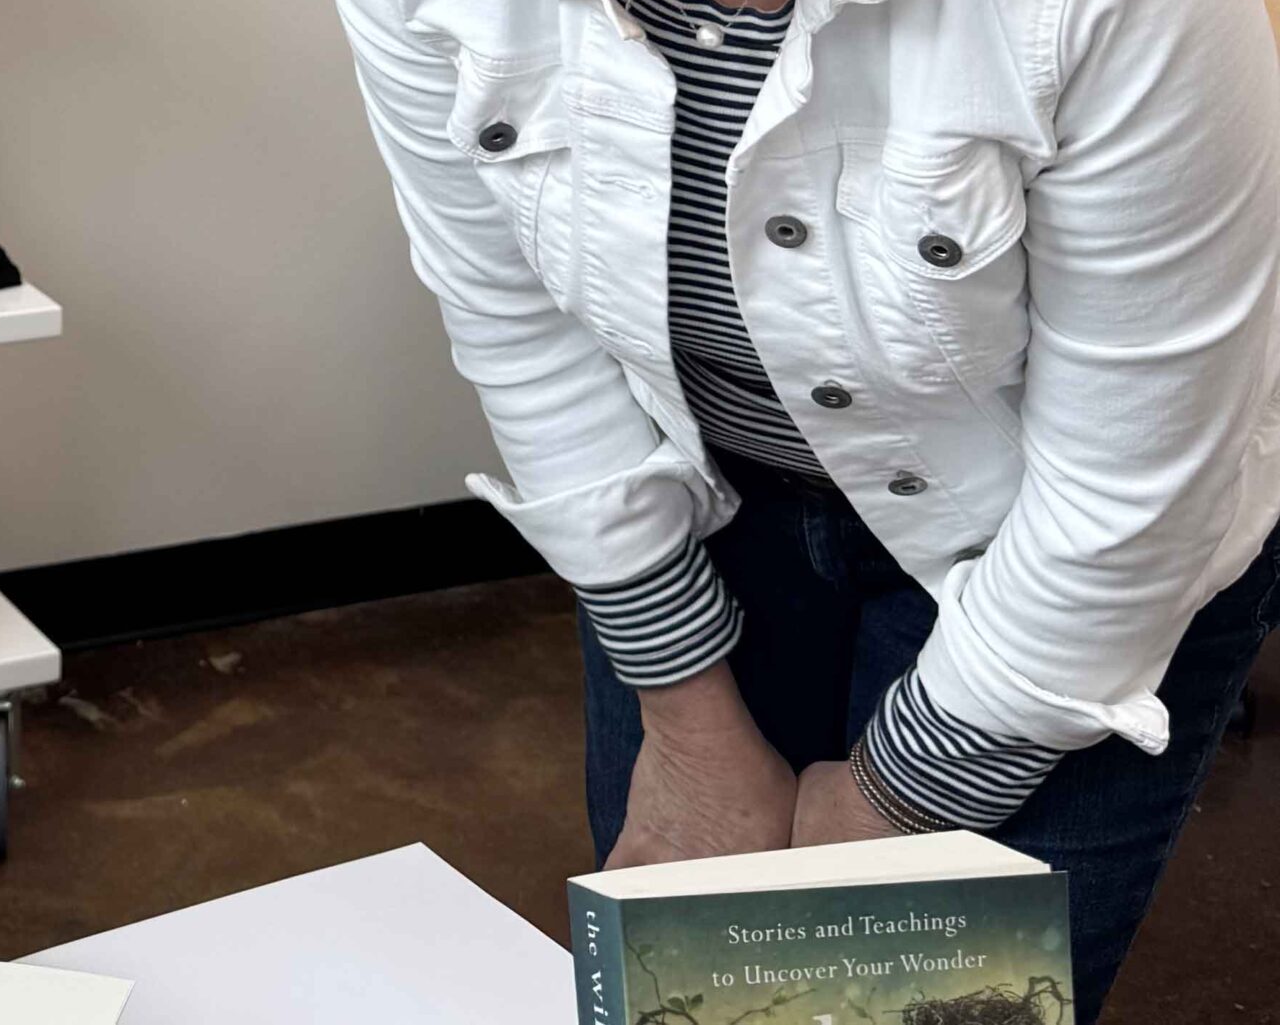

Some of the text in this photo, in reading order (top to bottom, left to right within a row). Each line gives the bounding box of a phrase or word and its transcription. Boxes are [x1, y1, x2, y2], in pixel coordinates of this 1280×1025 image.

[586, 910, 601, 957] the
[727, 911, 967, 945] Stories and Teachings
[711, 948, 988, 988] to Uncover Your Wonder
